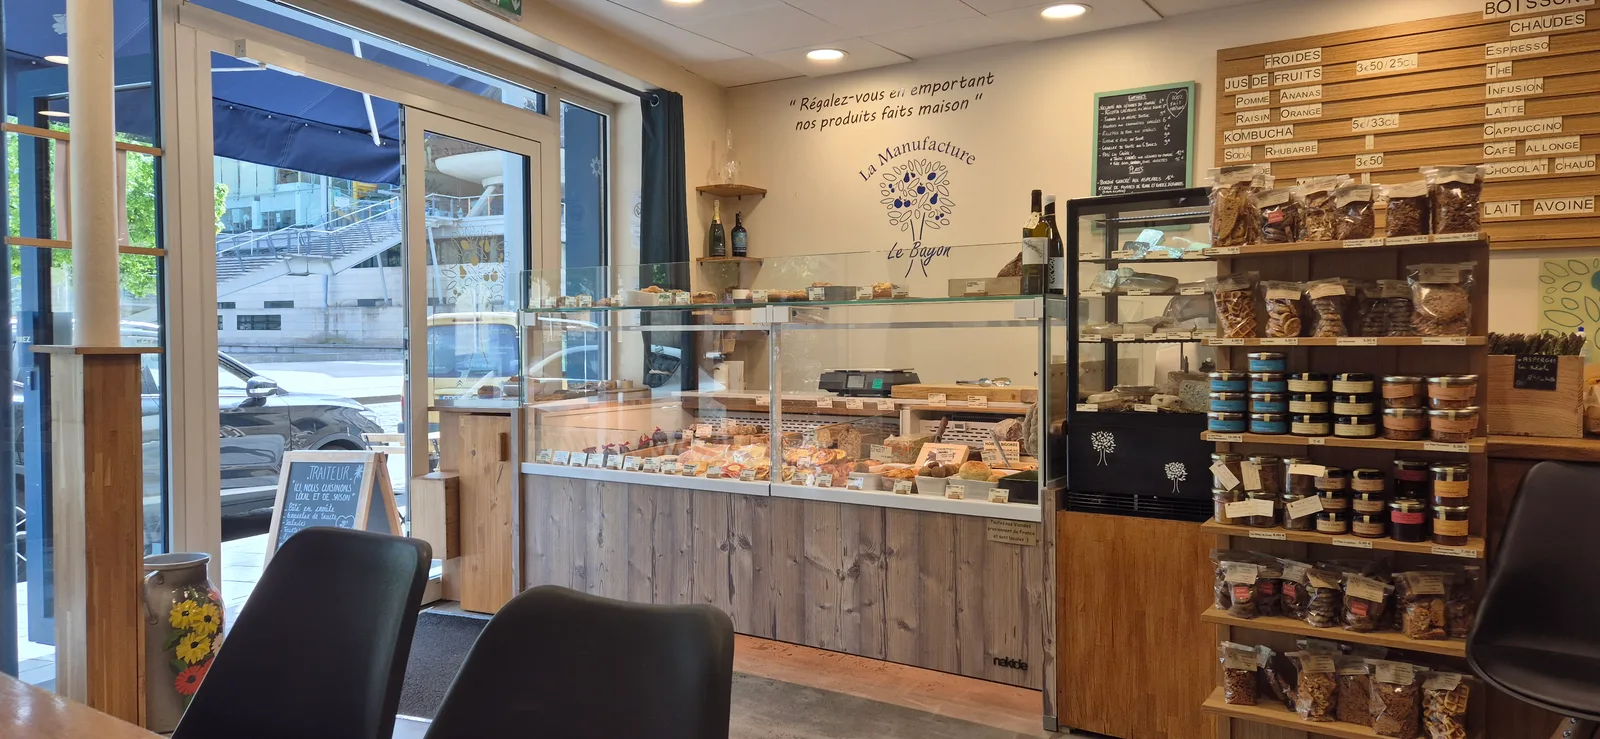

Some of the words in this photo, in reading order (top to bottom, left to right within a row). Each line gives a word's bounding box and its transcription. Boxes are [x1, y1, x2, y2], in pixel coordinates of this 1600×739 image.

[1510, 14, 1584, 33] CHAUDES
[1265, 50, 1321, 67] FROIDES
[1225, 78, 1248, 90] JUS
[1252, 75, 1268, 86] DE
[1274, 68, 1321, 84] FRUITS
[799, 89, 885, 112] Régalez-vous
[910, 72, 995, 97] emportant
[795, 118, 816, 131] nos
[820, 110, 876, 131] produits
[881, 104, 913, 120] faits
[918, 98, 969, 116] maison
[1224, 126, 1293, 143] KOMBUCHA
[858, 165, 877, 182] La
[877, 136, 977, 166] Manufacture
[1356, 156, 1384, 167] 3€50
[1555, 160, 1595, 171] CHAUD
[1484, 204, 1520, 216] LAIT
[1534, 199, 1594, 212] AVOINE
[887, 242, 904, 260] Le
[909, 242, 952, 266] Bayon
